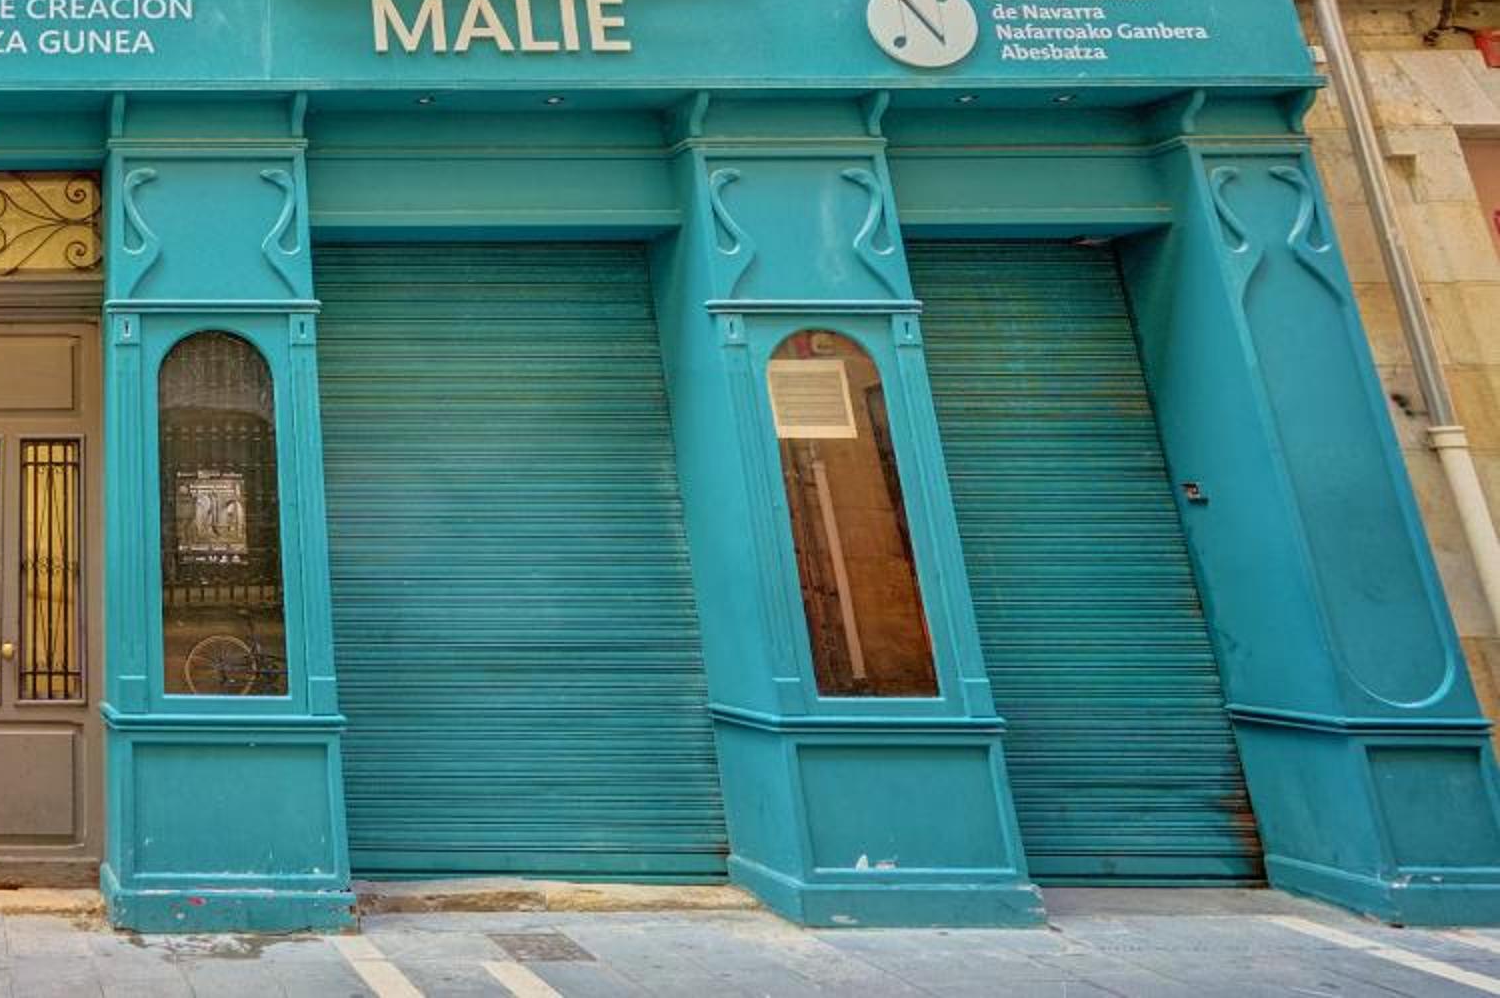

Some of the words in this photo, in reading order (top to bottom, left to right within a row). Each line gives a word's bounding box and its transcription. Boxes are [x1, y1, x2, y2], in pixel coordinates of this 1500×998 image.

[992, 3, 1018, 20] de
[1022, 4, 1106, 20] Navarra
[996, 22, 1113, 40] Nafarroako
[1117, 21, 1209, 40] Ganbera
[38, 29, 155, 54] GUNEA
[1001, 43, 1108, 60] Abesbatza
